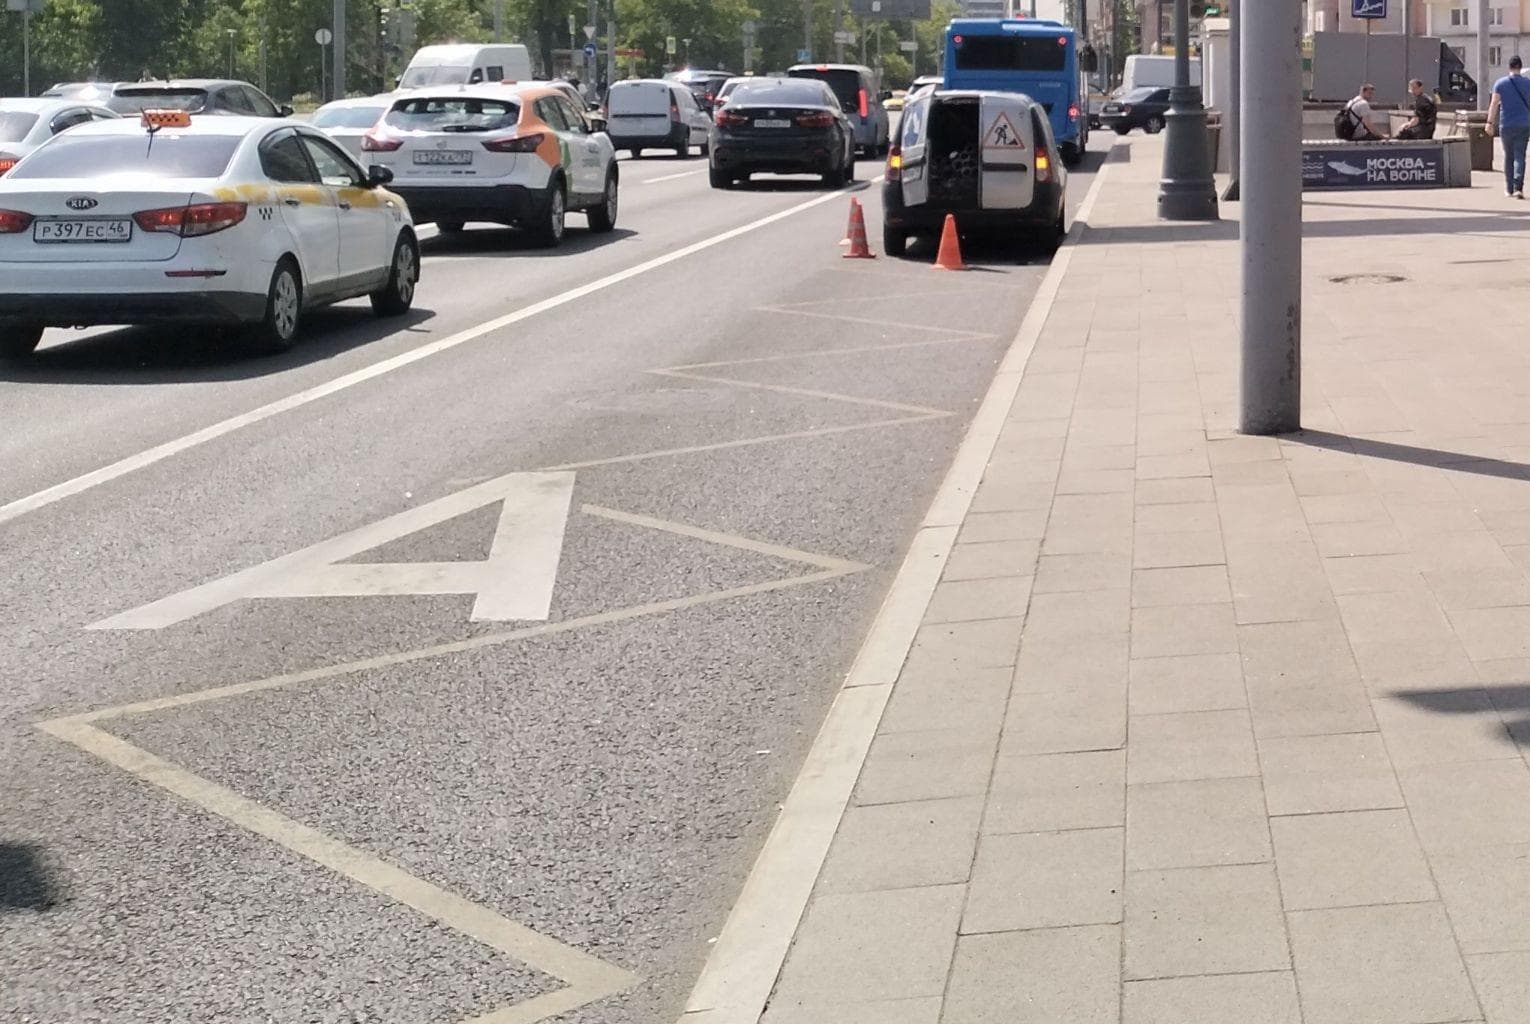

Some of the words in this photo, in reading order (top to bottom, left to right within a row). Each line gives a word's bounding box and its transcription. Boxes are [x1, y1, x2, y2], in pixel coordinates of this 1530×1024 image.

[1366, 158, 1425, 170] МОСКВА
[1366, 171, 1387, 182] НА
[1389, 169, 1436, 181] ВОЛНЕ
